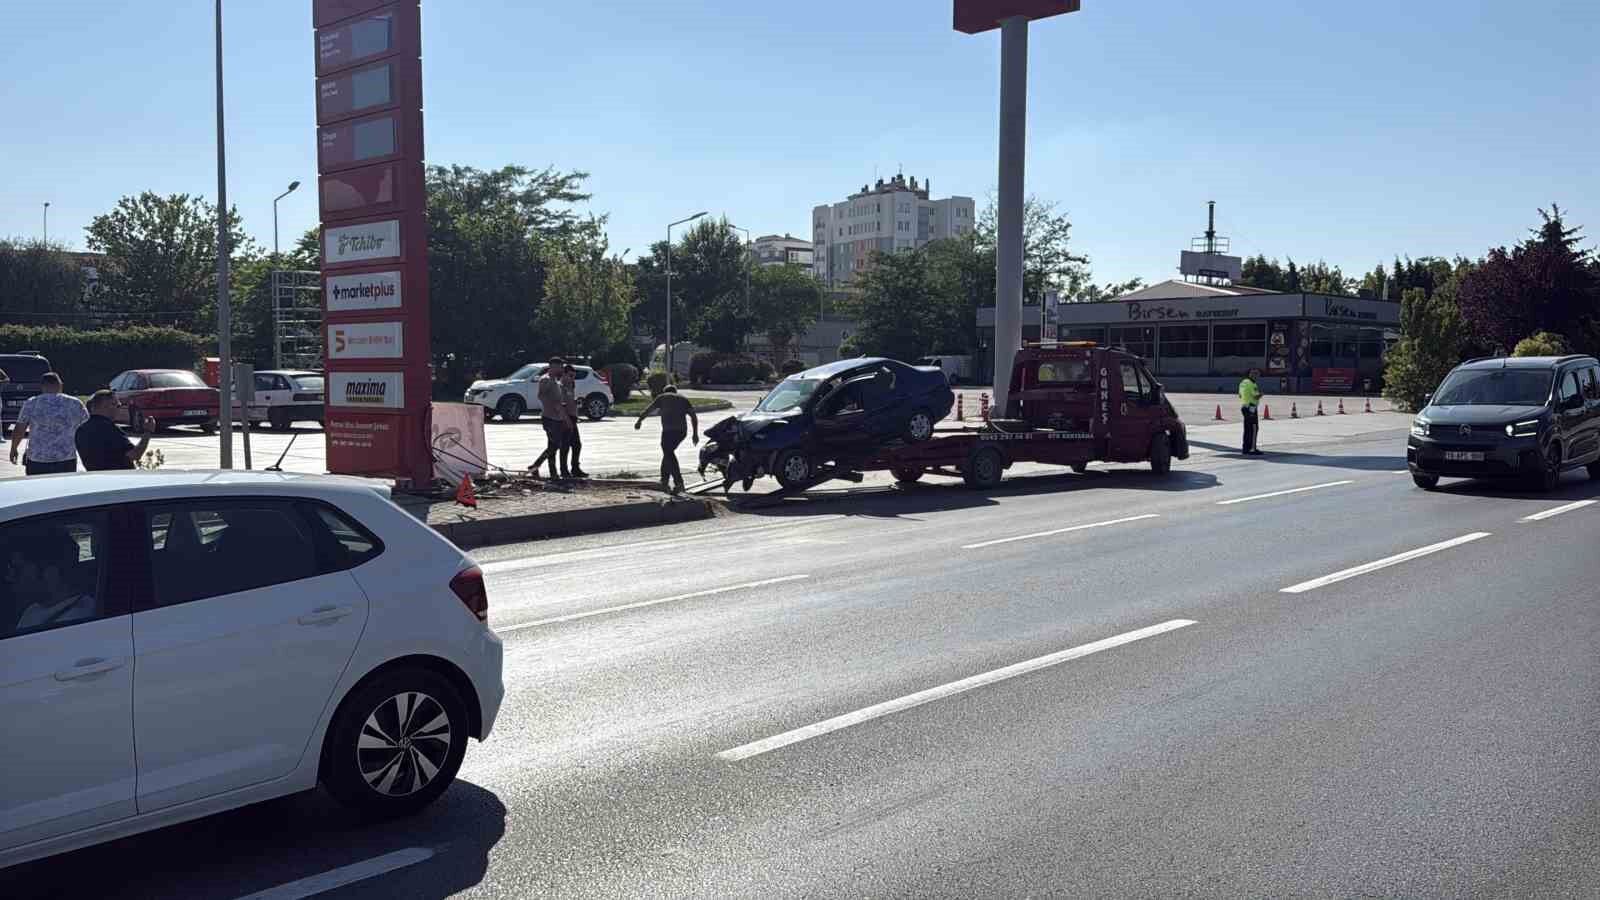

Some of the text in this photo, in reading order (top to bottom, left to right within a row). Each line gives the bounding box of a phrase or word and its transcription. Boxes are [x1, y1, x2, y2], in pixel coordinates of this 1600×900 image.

[351, 234, 384, 252] Tchibo
[1128, 303, 1190, 320] Birsen
[346, 378, 386, 395] maxima
